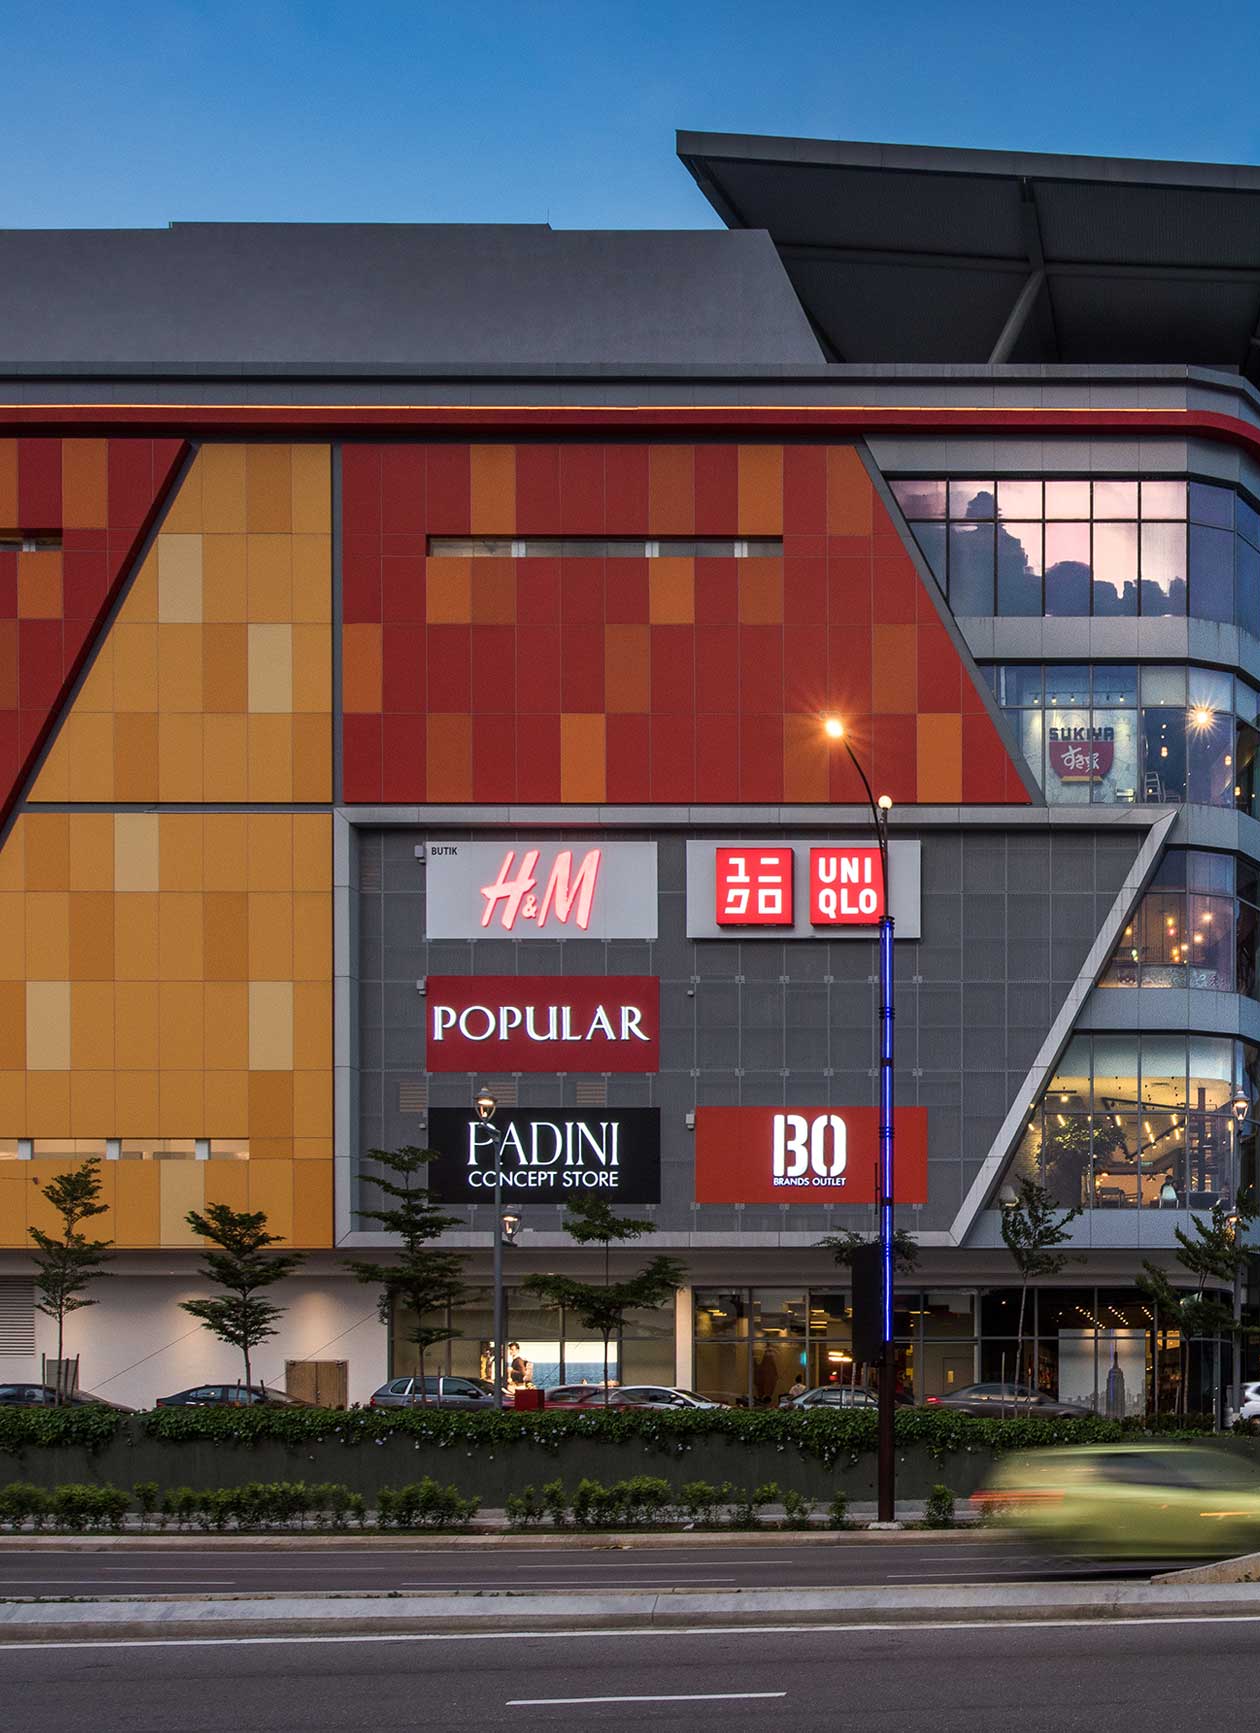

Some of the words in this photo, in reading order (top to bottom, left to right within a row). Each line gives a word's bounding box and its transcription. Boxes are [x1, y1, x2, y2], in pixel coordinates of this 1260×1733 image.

[431, 847, 458, 856] BUTIK
[480, 849, 601, 931] H&M
[433, 1004, 651, 1042] POPULAR
[467, 1121, 620, 1166] PADINI
[773, 1114, 847, 1177] BO
[468, 1171, 556, 1188] CONCEPT
[562, 1171, 619, 1187] STORE
[773, 1178, 809, 1186] BRANDS
[812, 1178, 846, 1186] OUTLET
